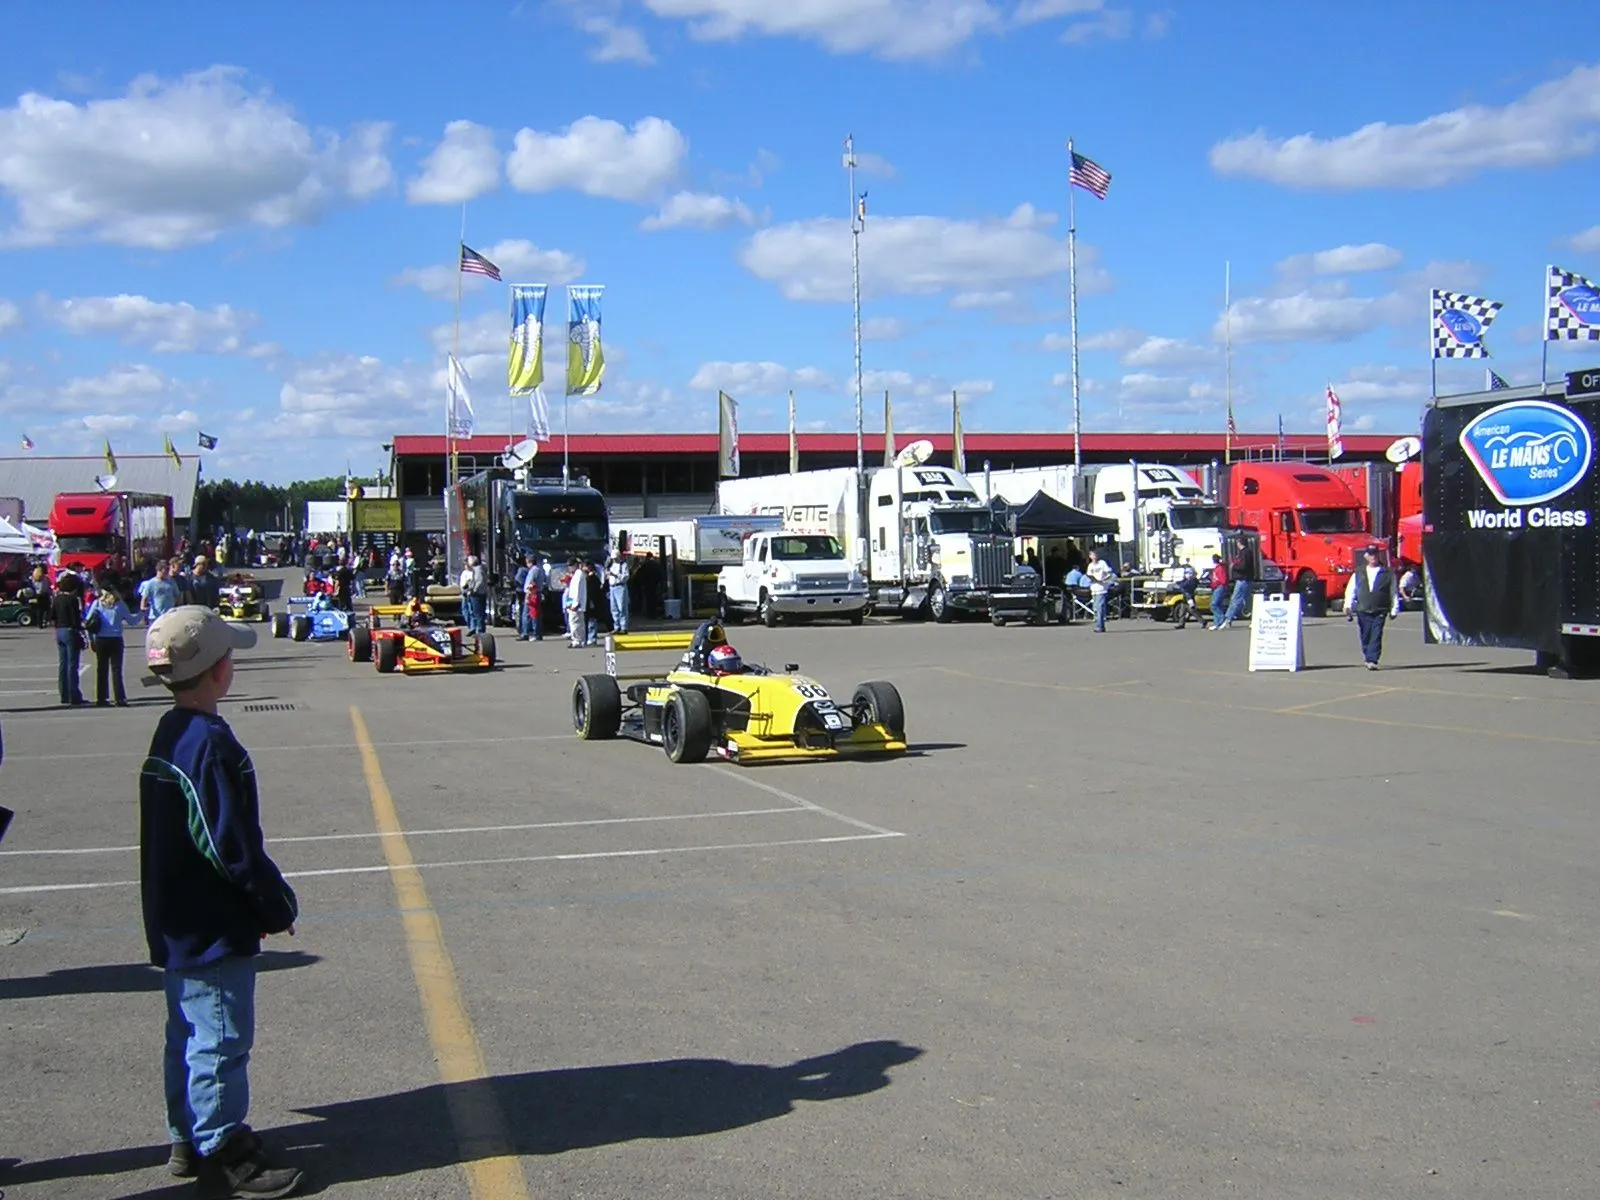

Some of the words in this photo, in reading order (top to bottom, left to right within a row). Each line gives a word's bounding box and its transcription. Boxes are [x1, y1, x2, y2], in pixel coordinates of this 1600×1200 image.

[1473, 424, 1511, 438] American
[1491, 447, 1509, 468] LE
[1529, 467, 1559, 480] Series
[1468, 509, 1522, 529] World
[1528, 507, 1587, 528] Class
[797, 684, 827, 698] 86
